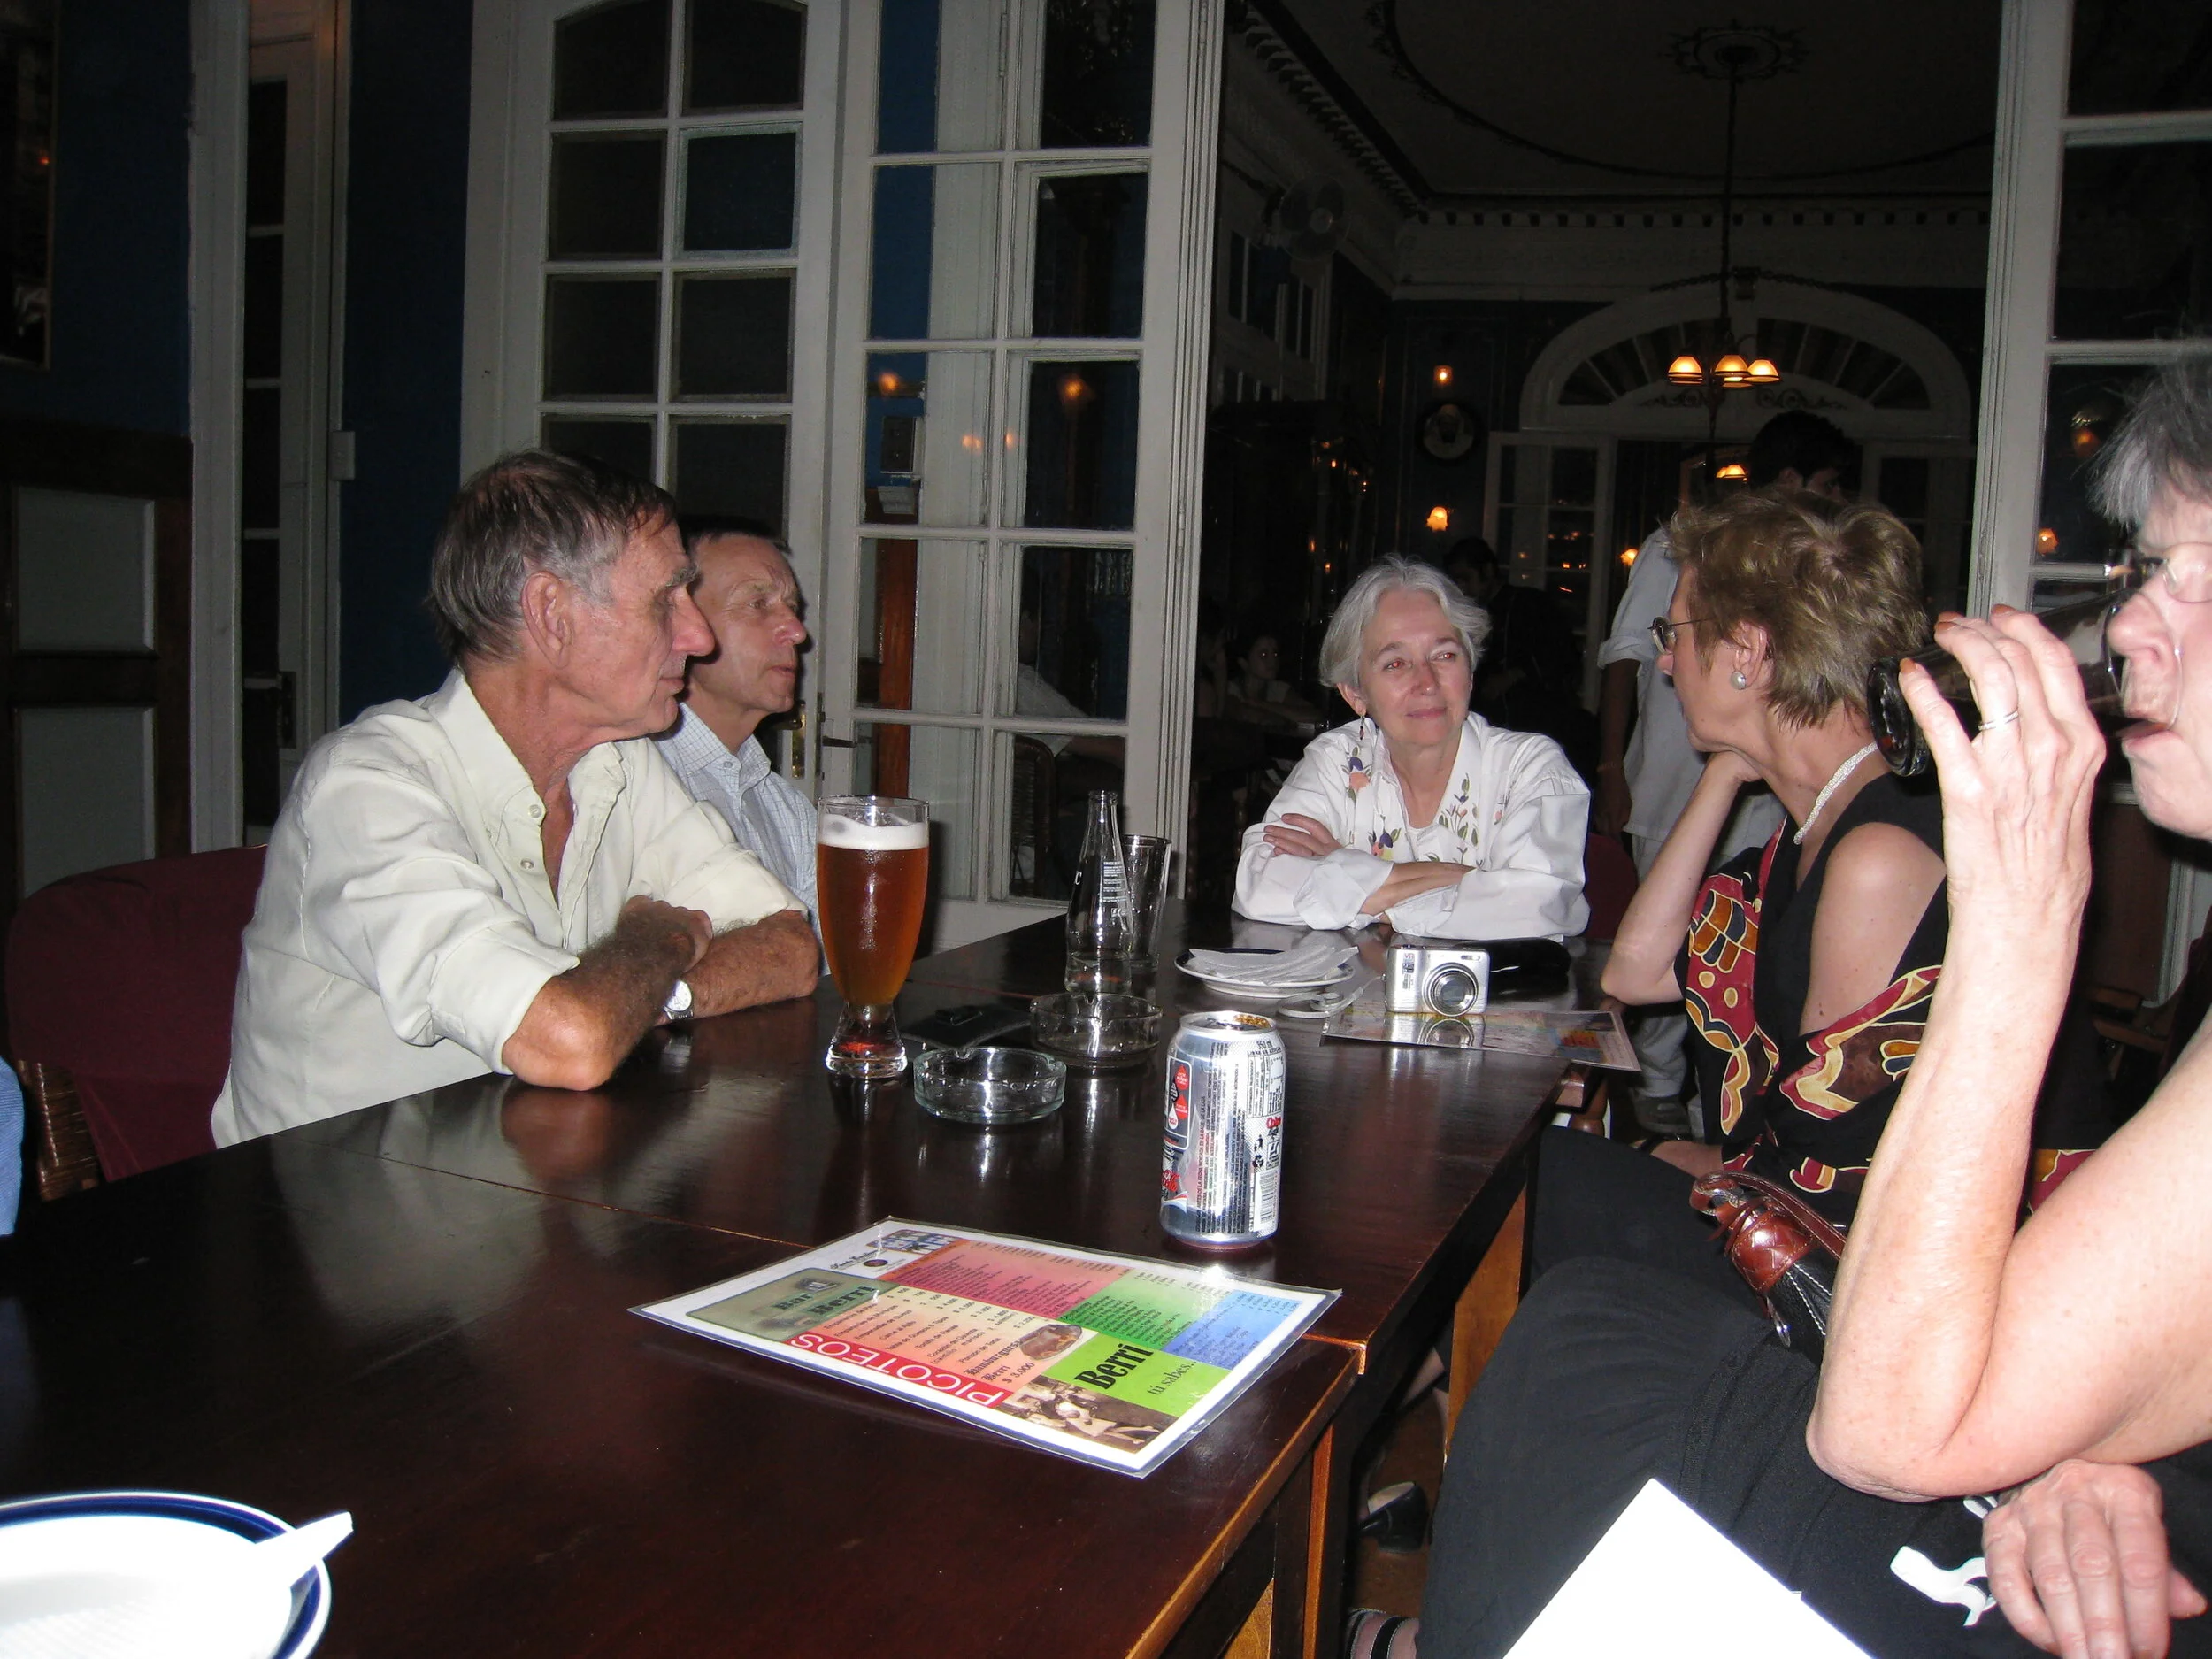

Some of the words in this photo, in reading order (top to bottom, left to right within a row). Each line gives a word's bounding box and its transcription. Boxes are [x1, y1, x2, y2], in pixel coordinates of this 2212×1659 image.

[772, 1294, 812, 1310] Bar
[807, 1286, 875, 1315] Berri
[791, 1334, 1003, 1406] PICOTEOS
[1010, 1363, 1035, 1378] 3.000
[1074, 1343, 1154, 1390] Berri
[1147, 1383, 1165, 1396] tú
